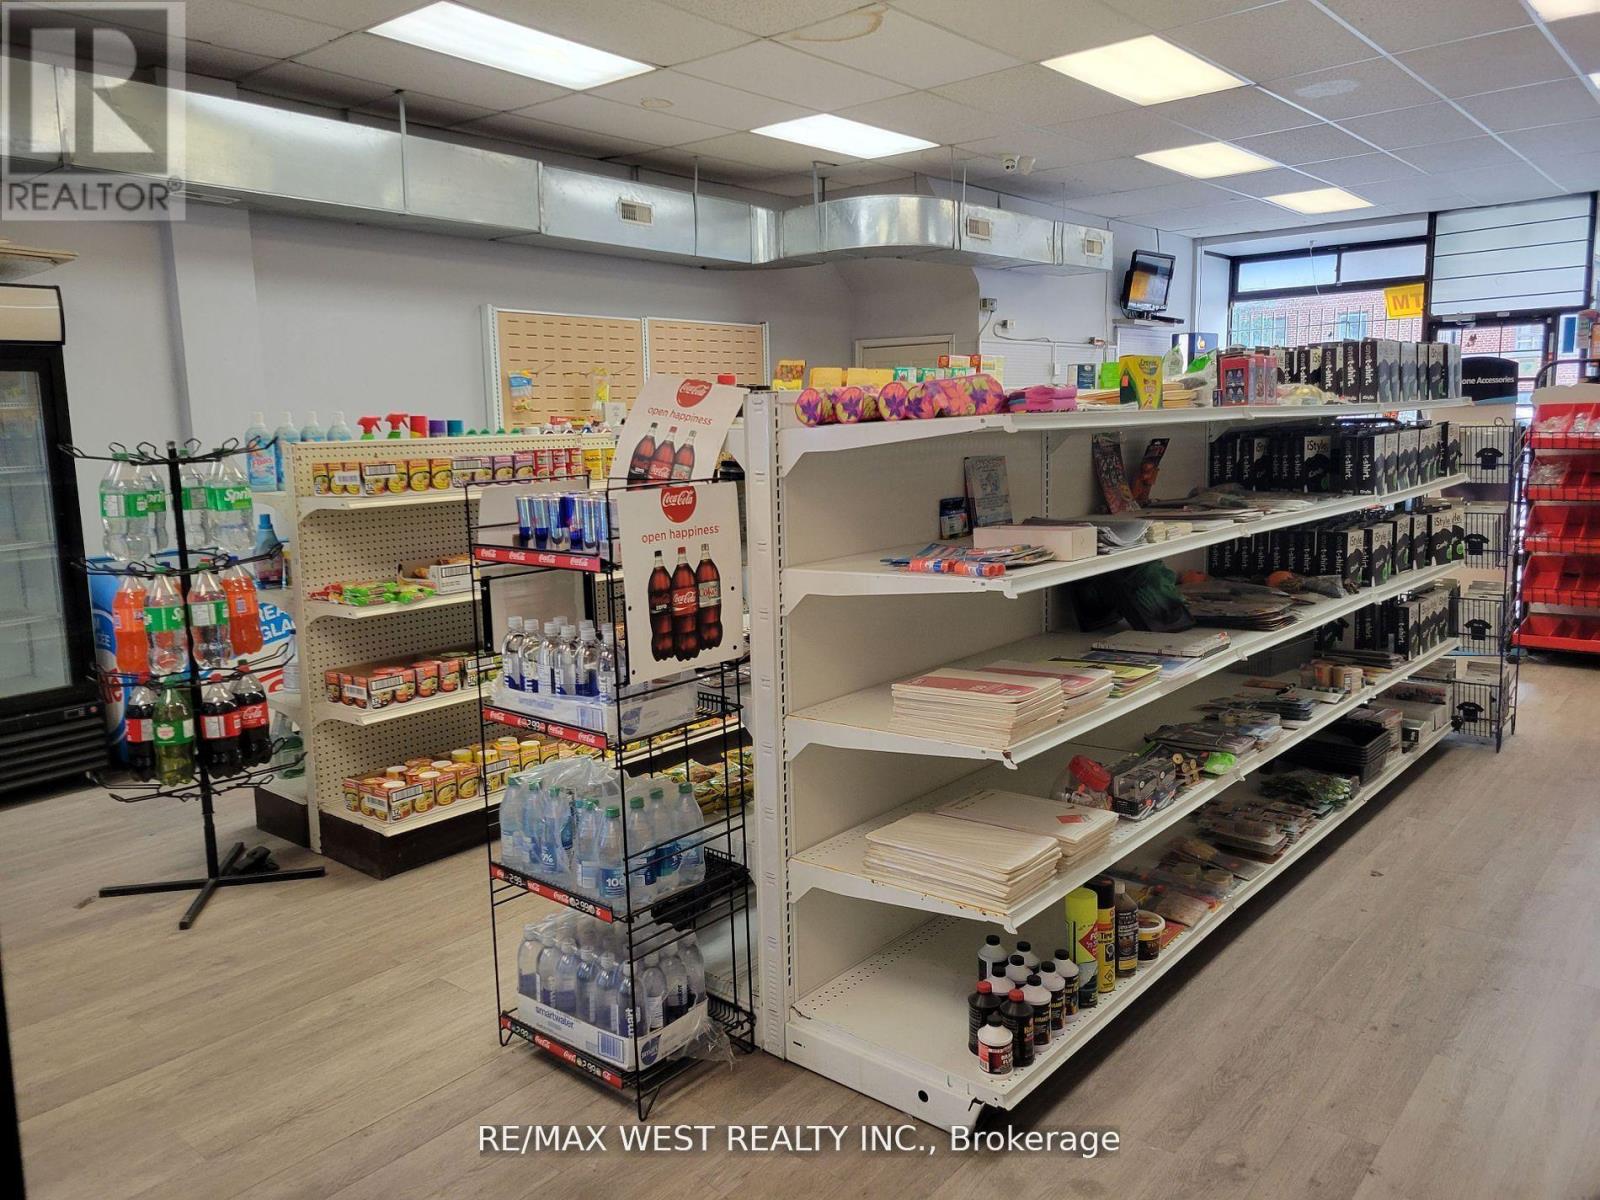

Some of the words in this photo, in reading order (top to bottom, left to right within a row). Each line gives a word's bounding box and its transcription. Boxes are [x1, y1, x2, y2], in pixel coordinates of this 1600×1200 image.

[1476, 376, 1515, 384] Accessories
[647, 407, 668, 416] open
[669, 409, 713, 425] happiness
[641, 531, 667, 544] open
[669, 525, 720, 540] happiness
